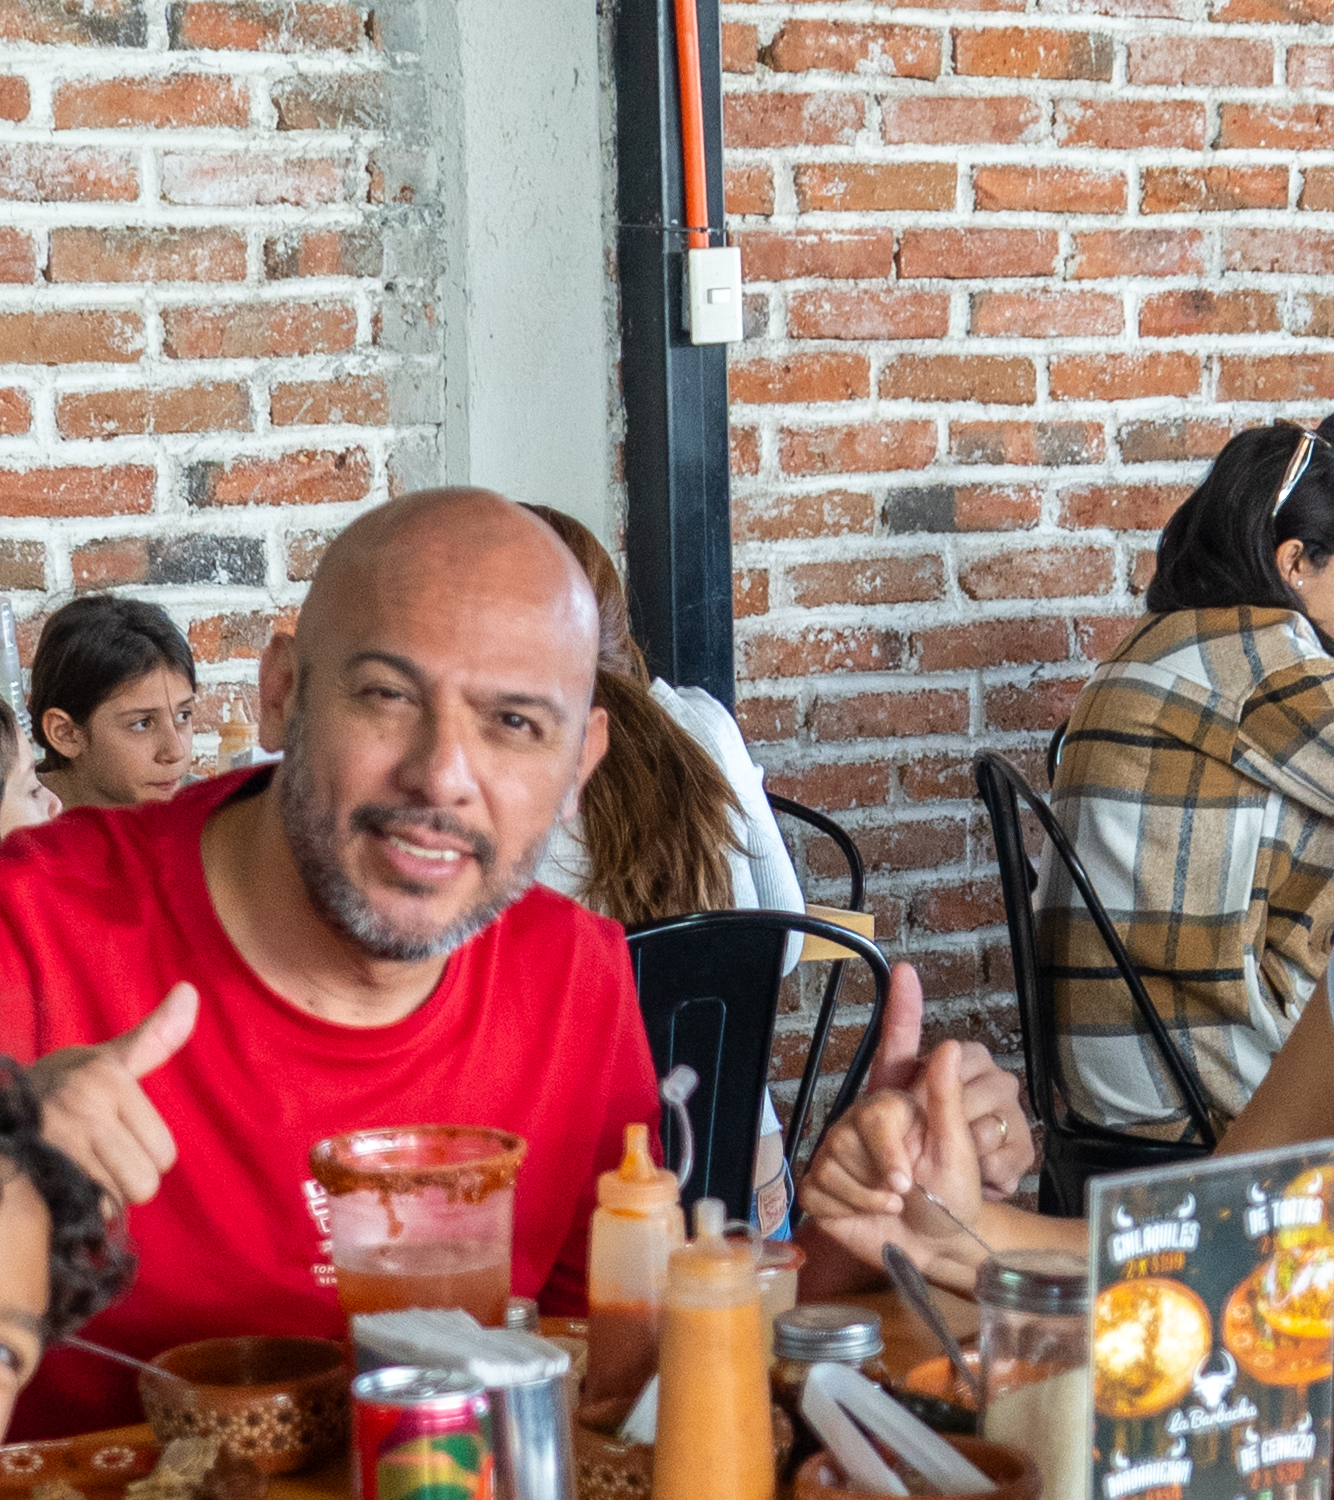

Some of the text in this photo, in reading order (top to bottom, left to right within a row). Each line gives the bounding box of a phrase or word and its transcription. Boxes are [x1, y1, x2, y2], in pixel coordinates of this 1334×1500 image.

[1247, 1206, 1269, 1236] DE
[1112, 1220, 1199, 1262] CHILAQUILES
[1189, 1397, 1258, 1429] Barbacha
[1240, 1432, 1316, 1472] DE CERVEZA
